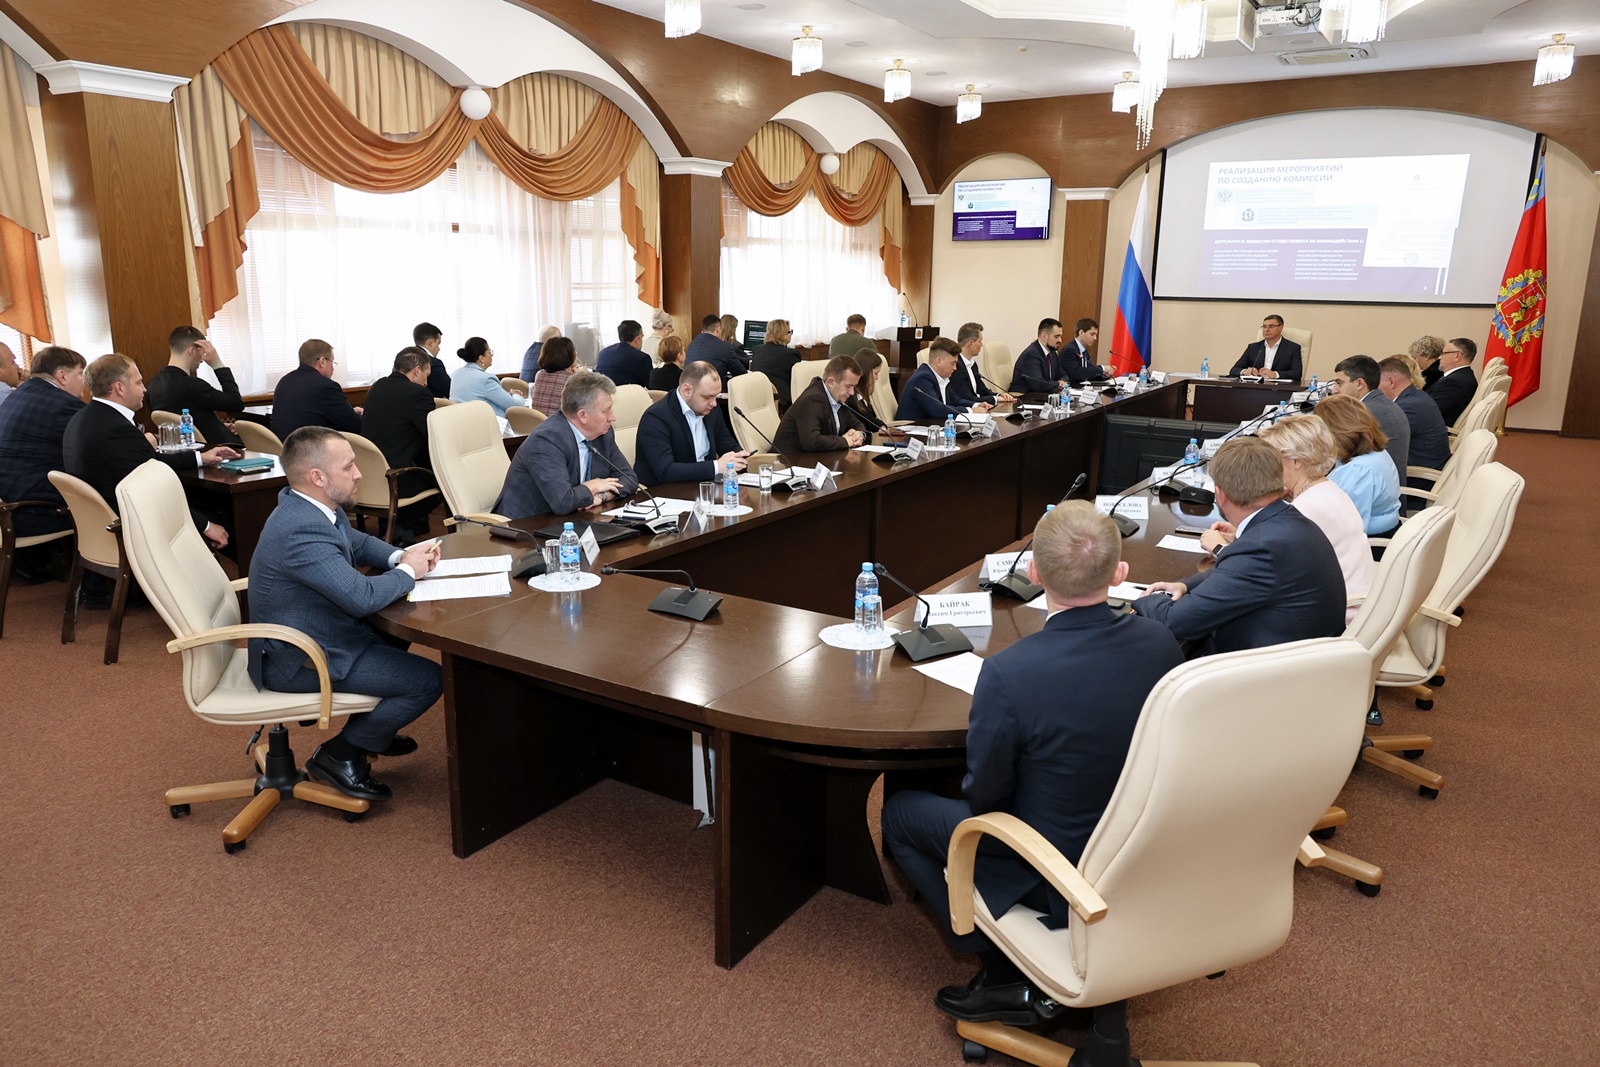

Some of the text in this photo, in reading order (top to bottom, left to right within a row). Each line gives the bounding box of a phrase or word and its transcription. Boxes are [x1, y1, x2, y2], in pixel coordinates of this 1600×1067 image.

[1218, 164, 1343, 175] РЕАЛИЗАЦИЯ МЕРОПРИЯТИЙ
[1232, 176, 1281, 184] СОЗДАНИЮ
[940, 600, 970, 608] БАЙРАК
